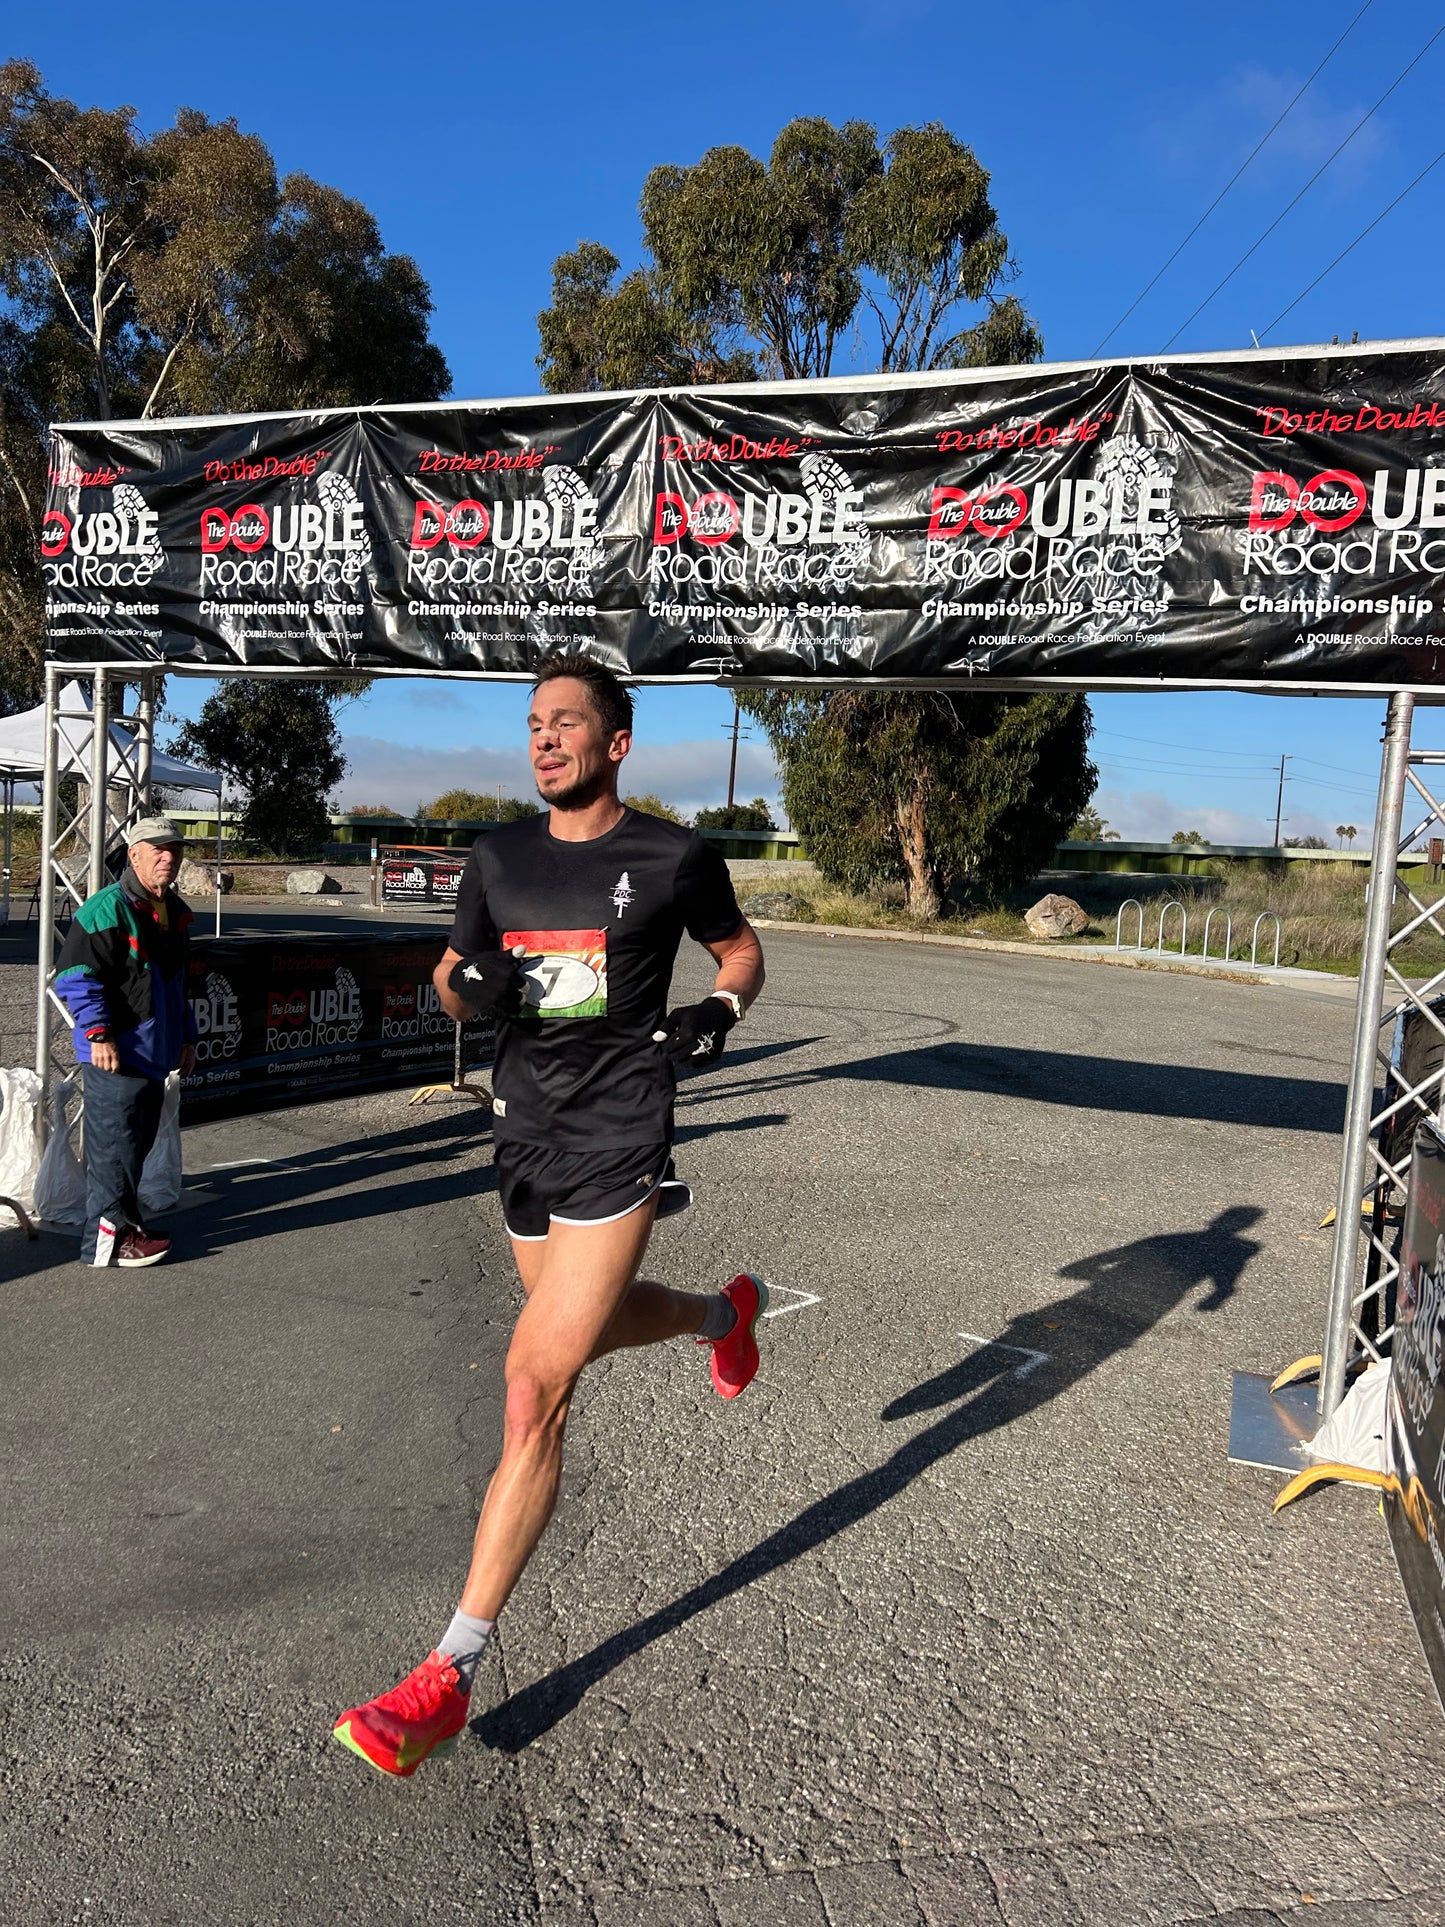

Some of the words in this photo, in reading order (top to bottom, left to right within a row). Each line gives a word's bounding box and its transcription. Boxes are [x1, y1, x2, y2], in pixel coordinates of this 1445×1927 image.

[1305, 408, 1354, 433] the
[692, 435, 728, 461] the
[977, 423, 1018, 449] the
[232, 457, 262, 481] the
[450, 452, 482, 471] the
[928, 477, 1173, 540] DOUBLE
[938, 505, 965, 524] The
[967, 501, 1021, 522] Double
[1249, 468, 1445, 533] DOUB
[1260, 493, 1290, 513] The
[1296, 490, 1359, 512] Double
[201, 502, 364, 553] DOUBLE
[206, 522, 226, 538] The
[229, 521, 265, 538] Double
[411, 499, 598, 549] DOUBLE
[419, 517, 440, 534] The
[443, 515, 485, 535] Double
[653, 491, 864, 546] DOUBLE
[661, 509, 683, 527] The
[686, 506, 734, 530] Double
[41, 510, 159, 557] OUBLE
[650, 545, 748, 584] Road
[754, 547, 857, 584] Race
[923, 535, 1039, 581] Road
[1046, 537, 1166, 578] Race
[1242, 529, 1379, 576] Road
[82, 556, 154, 587] Race
[199, 551, 278, 586] Road
[283, 551, 362, 585] Race
[407, 549, 496, 584] Road
[501, 549, 592, 584] Race
[115, 601, 159, 616] Series
[199, 600, 310, 618] Championship
[313, 600, 364, 616] Series
[408, 601, 531, 620] Championship
[537, 601, 597, 617] Series
[648, 601, 789, 621] Championship
[796, 601, 862, 618] Series
[921, 598, 1084, 620] Championship
[1091, 596, 1169, 614] Series
[1239, 594, 1433, 620] Championship
[240, 630, 267, 639] DOUBLE
[268, 630, 287, 639] Road
[288, 630, 305, 639] Race
[444, 632, 450, 641] A
[451, 631, 481, 641] DOUBLE
[482, 631, 503, 641] Road
[505, 632, 525, 642] Race
[688, 635, 696, 644] A
[697, 634, 733, 645] DOUBLE
[758, 635, 782, 645] ace
[833, 635, 858, 646] Even
[968, 636, 977, 645] A
[979, 634, 1017, 645] DOUBLE
[1018, 633, 1046, 644] Road
[1047, 632, 1075, 643] Race
[1076, 631, 1133, 643] Federation
[1135, 630, 1166, 642] Event
[1294, 633, 1304, 644] A
[1307, 633, 1353, 645] DOUBLE
[1354, 633, 1387, 645] Road
[1390, 634, 1423, 646] Race
[613, 889, 632, 899] PDC
[541, 966, 564, 998] 7
[267, 986, 360, 1026] DOUBLE
[271, 1003, 283, 1016] The
[383, 984, 444, 1017] DOUB
[265, 1023, 313, 1052] Road
[316, 1022, 358, 1046] Race
[381, 1014, 420, 1039] Road
[421, 1013, 455, 1035] Race
[195, 1037, 236, 1061] ace
[381, 1044, 433, 1059] Championship
[267, 1055, 332, 1074] Championship
[334, 1053, 361, 1065] Series
[206, 1070, 241, 1084] Series
